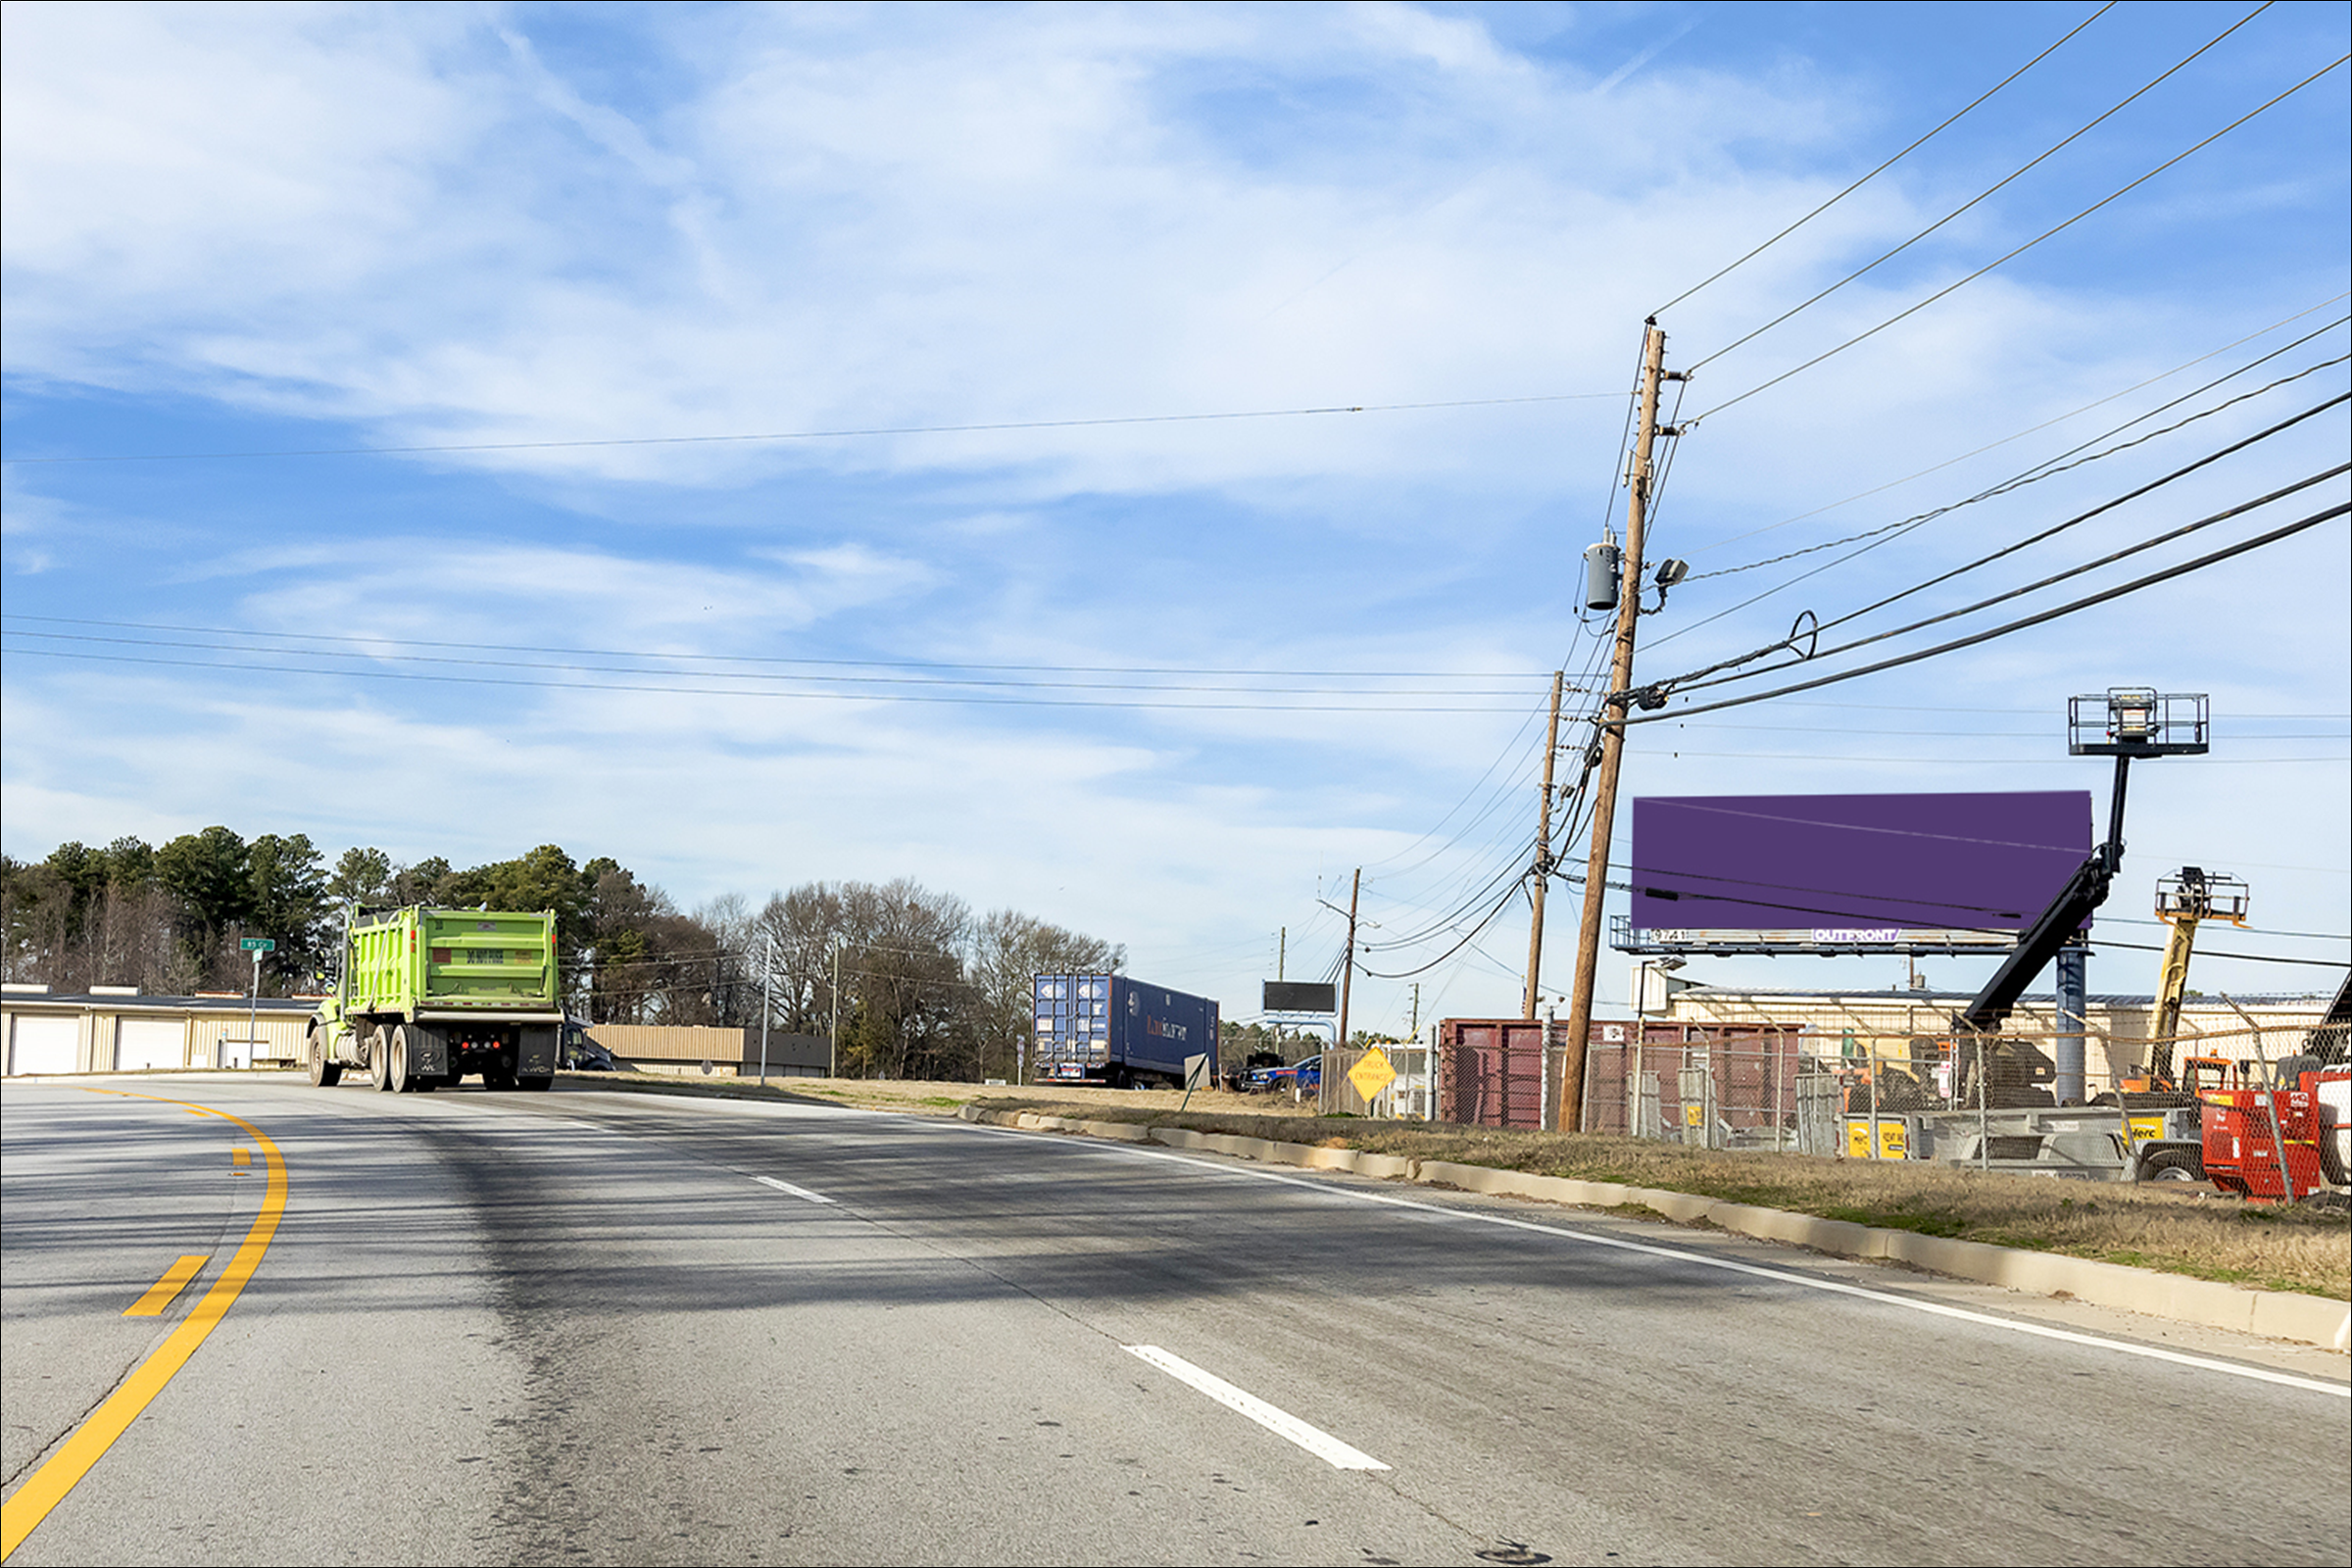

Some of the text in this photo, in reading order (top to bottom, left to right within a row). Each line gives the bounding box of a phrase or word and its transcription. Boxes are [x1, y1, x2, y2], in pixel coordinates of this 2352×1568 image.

[1815, 929, 1896, 941] OUTFRONT
[1363, 1060, 1384, 1069] TRUCK
[1354, 1072, 1389, 1082] ENTRANCE
